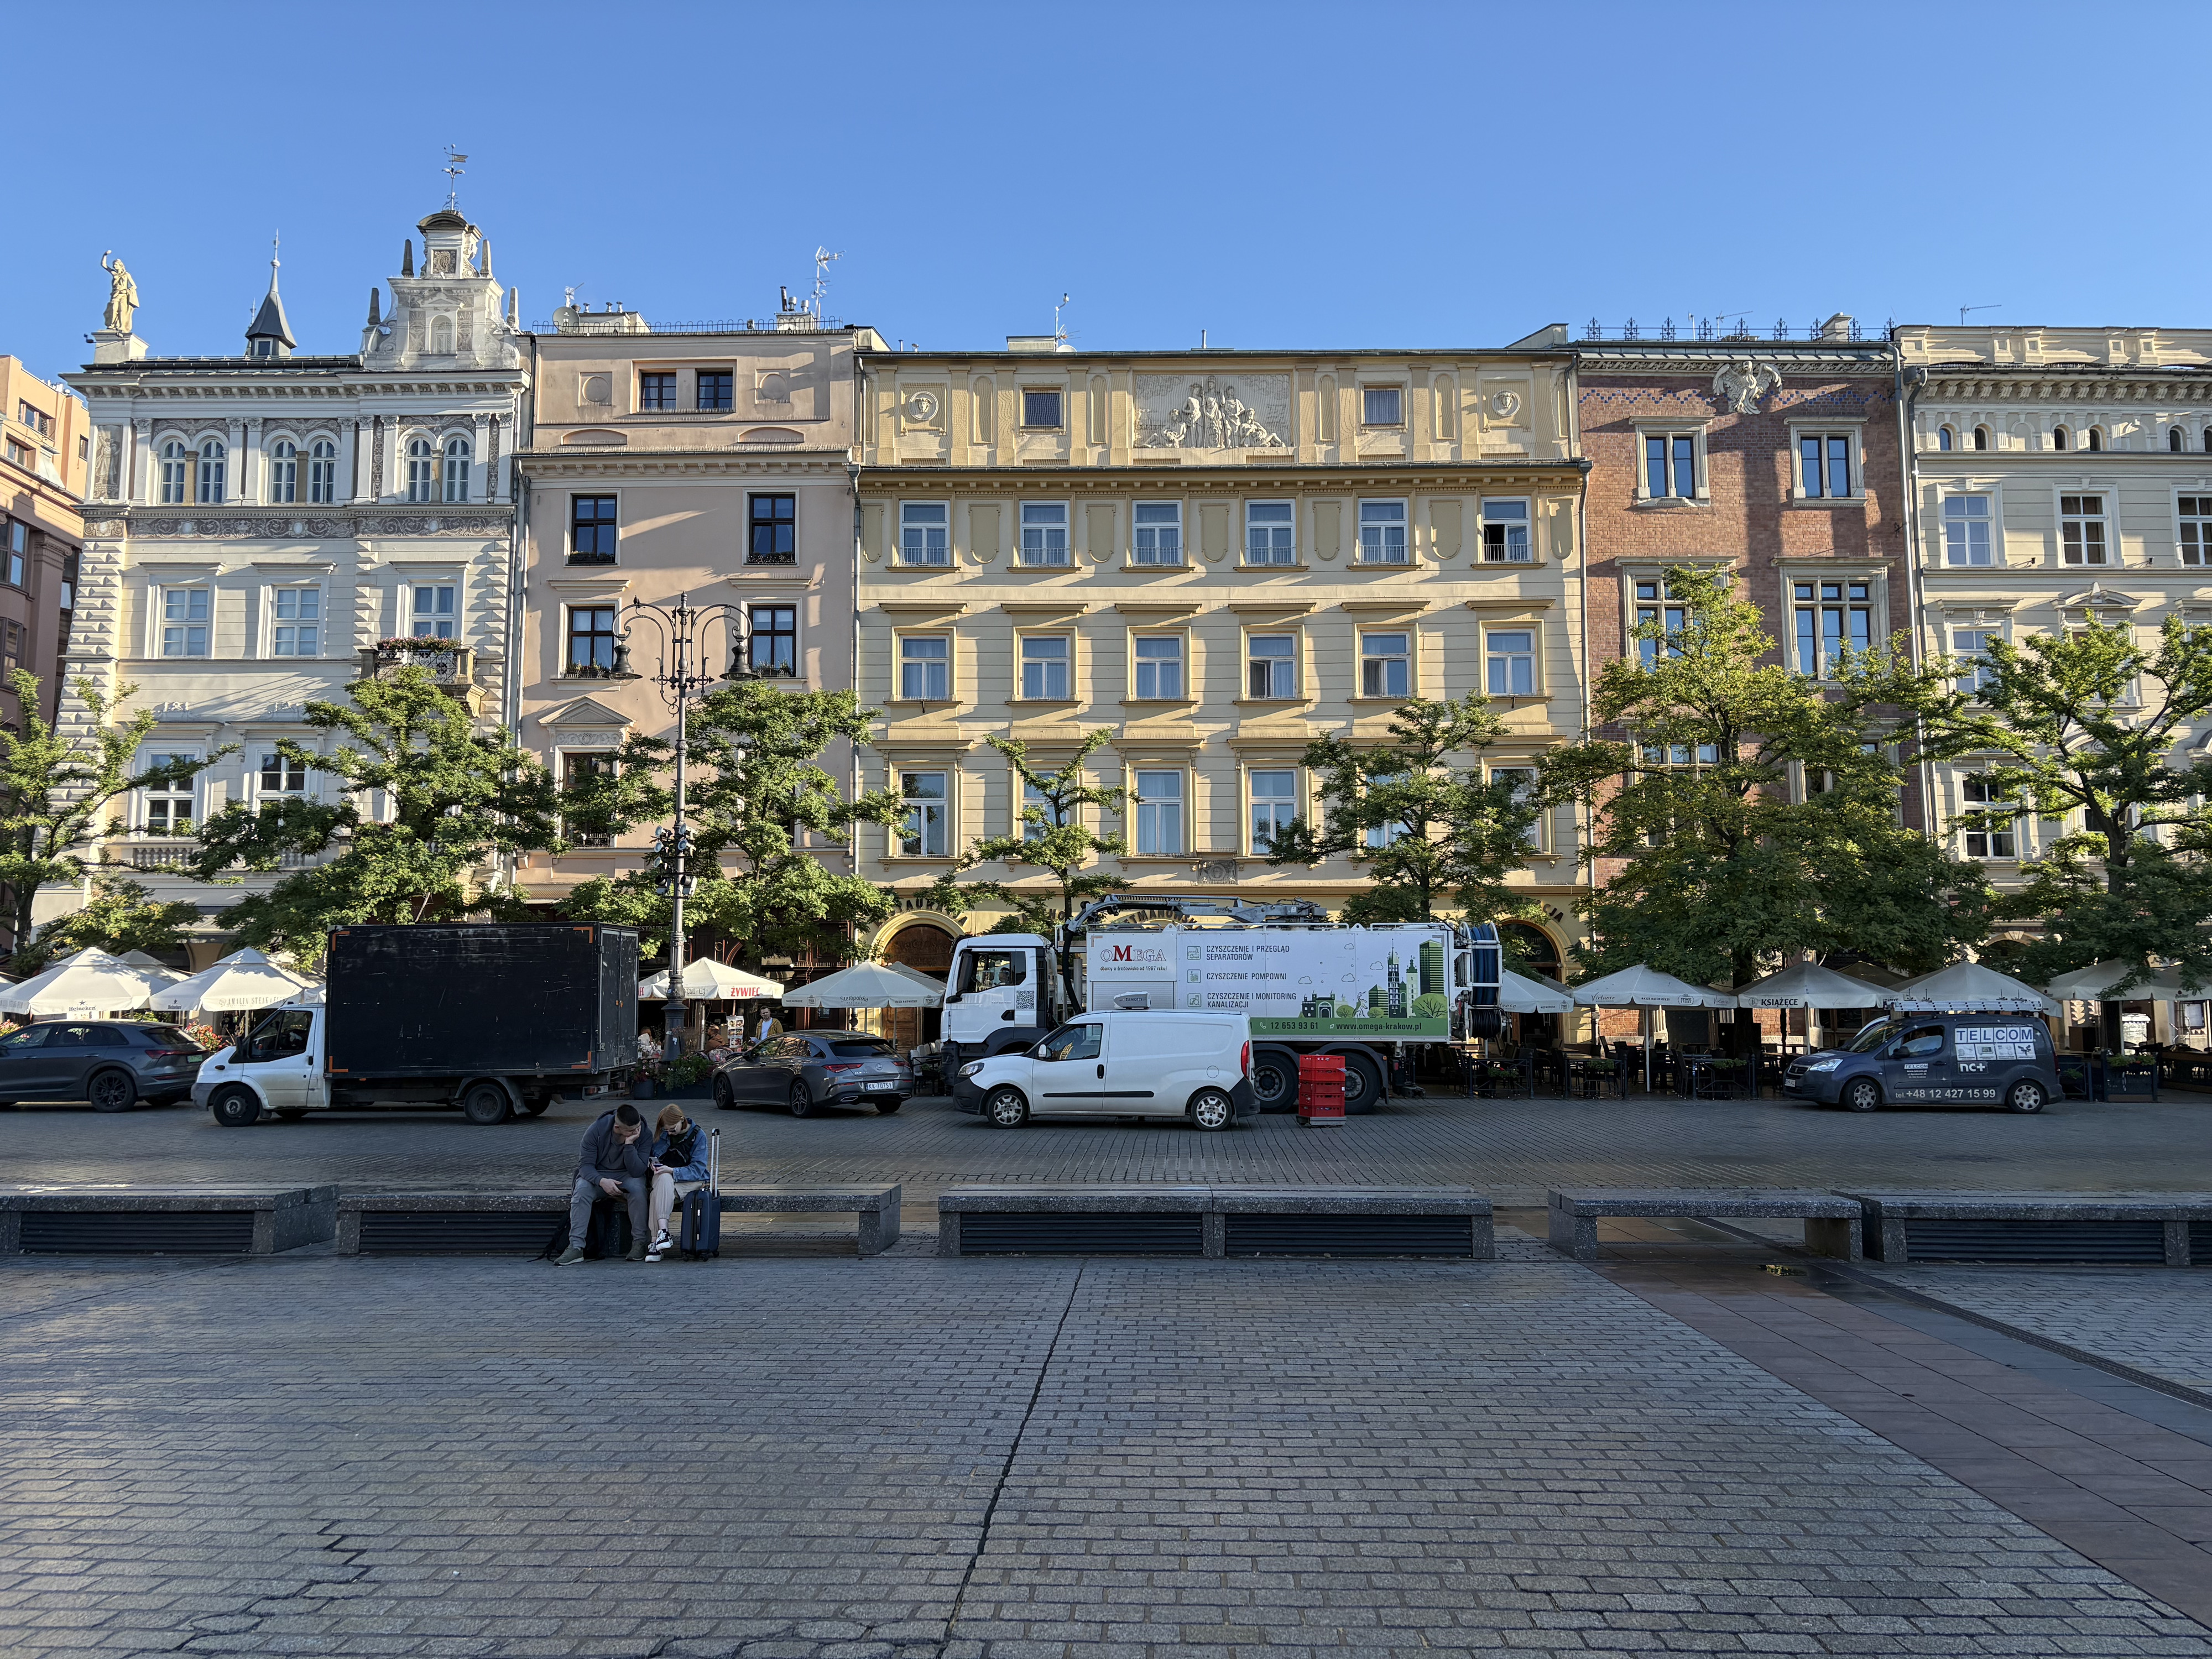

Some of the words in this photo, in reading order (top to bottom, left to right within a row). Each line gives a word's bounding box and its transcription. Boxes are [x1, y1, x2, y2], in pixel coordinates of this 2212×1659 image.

[1256, 945, 1290, 953] PRZEGLĄD
[1206, 952, 1253, 961] SEPARATORÓW
[731, 985, 760, 997] ŻYWIEC
[1591, 992, 1615, 1001] Virtuoso
[1761, 997, 1798, 1007] KSIĄŻĘCE
[1336, 1022, 1422, 1031] www.omega-krakow.pl
[1956, 1029, 2032, 1041] TELCOM
[1960, 1062, 1986, 1072] nc+
[1906, 1089, 1926, 1098] +48
[1929, 1089, 1942, 1098] 12
[1945, 1089, 1964, 1098] 427
[1968, 1089, 1980, 1098] 15
[1983, 1089, 1996, 1098] 99
